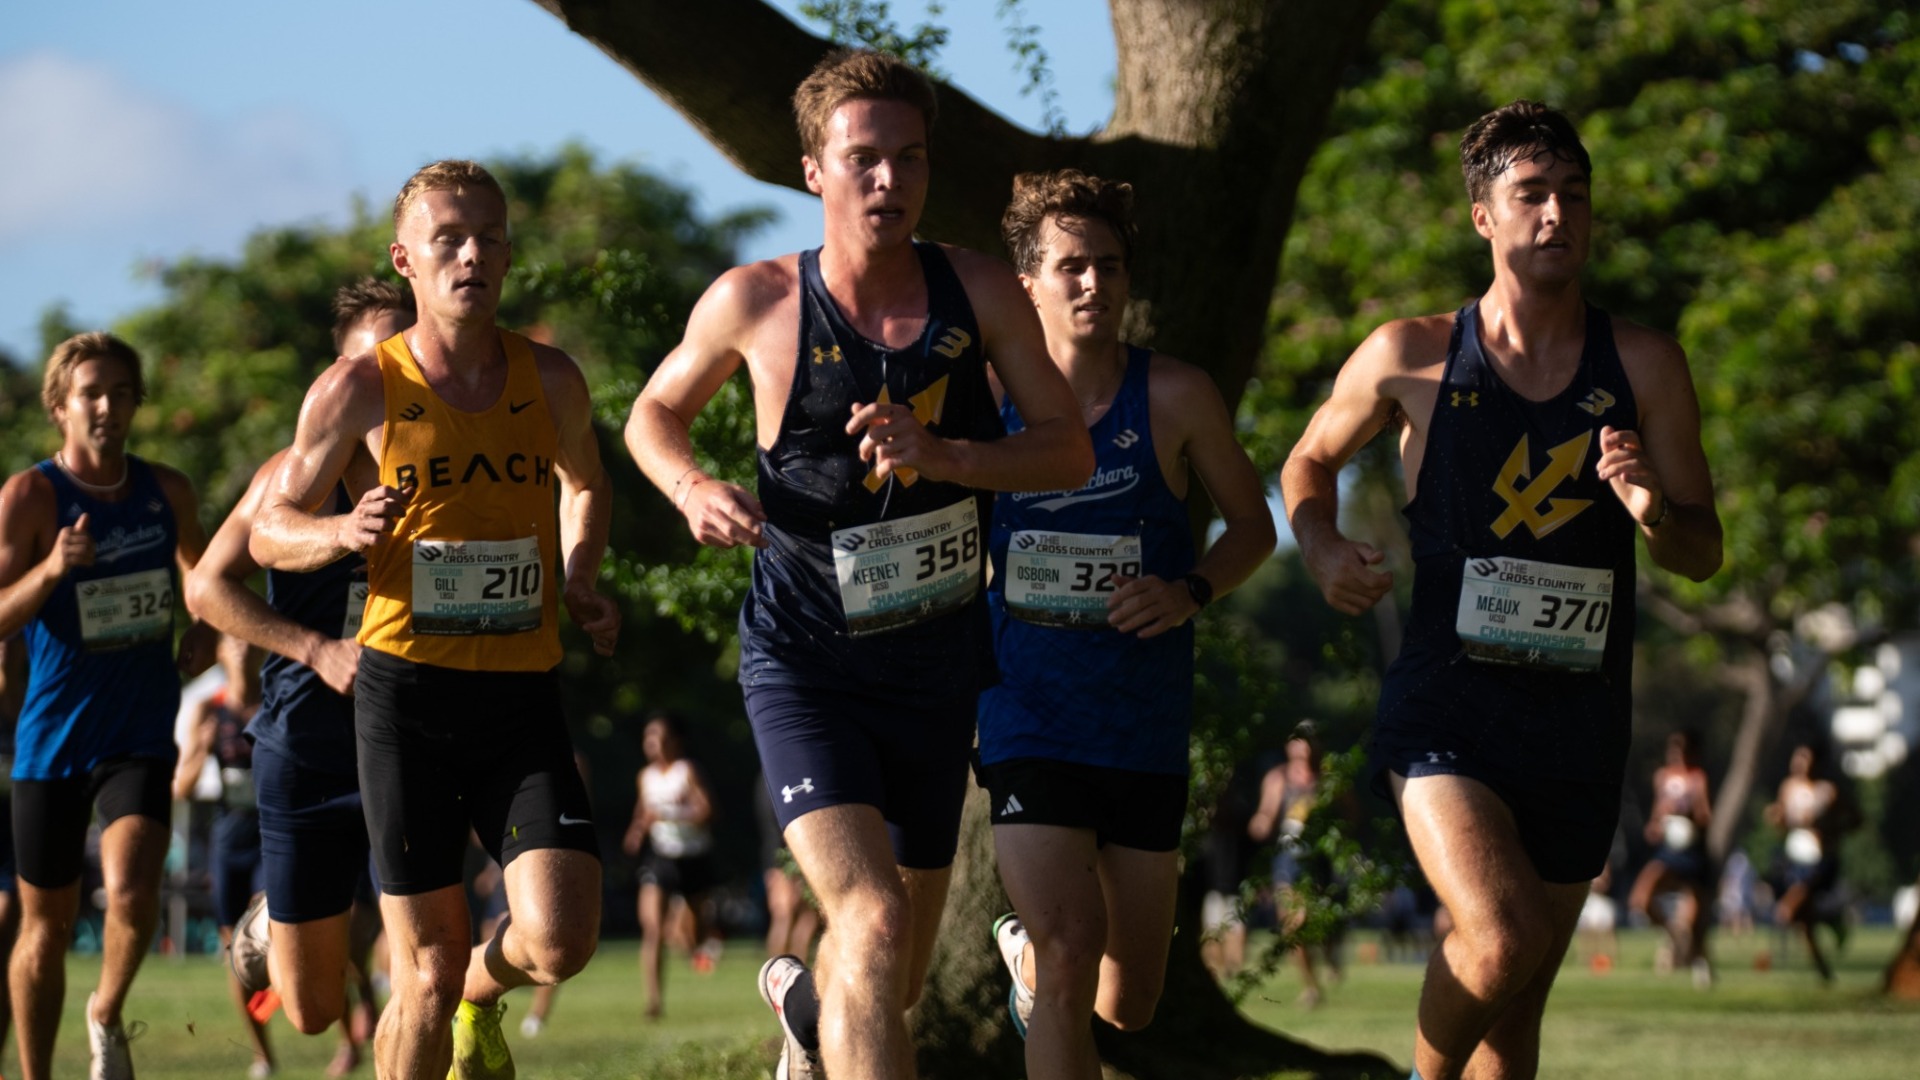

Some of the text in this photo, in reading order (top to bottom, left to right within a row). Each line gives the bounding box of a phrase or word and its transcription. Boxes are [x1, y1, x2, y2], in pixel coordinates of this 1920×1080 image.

[396, 453, 549, 491] BEACH
[867, 525, 895, 540] THE
[868, 534, 904, 549] CROSS
[905, 521, 952, 542] COUNTRY
[1039, 535, 1060, 545] THE
[443, 553, 519, 564] CROSS COUNTRY
[445, 545, 467, 555] THE
[853, 526, 978, 586] KEENEY 358
[1036, 544, 1068, 555] CROSS
[1070, 546, 1114, 557] COUNTRY
[859, 552, 890, 567] JEFFREY
[1503, 561, 1528, 573] THE
[435, 562, 540, 600] GILL 210
[1017, 566, 1059, 583] OSBORN
[1500, 572, 1535, 585] CROSS
[1538, 577, 1586, 591] COUNTRY
[868, 569, 968, 610] CHAMPIONSHIPS
[1492, 586, 1511, 597] TATE
[129, 588, 173, 619] 324
[434, 599, 529, 613] CHAMPIONSHIPS
[1476, 594, 1610, 633] MEAUX 370
[1480, 624, 1586, 648] CHAMPIONSHIPS
